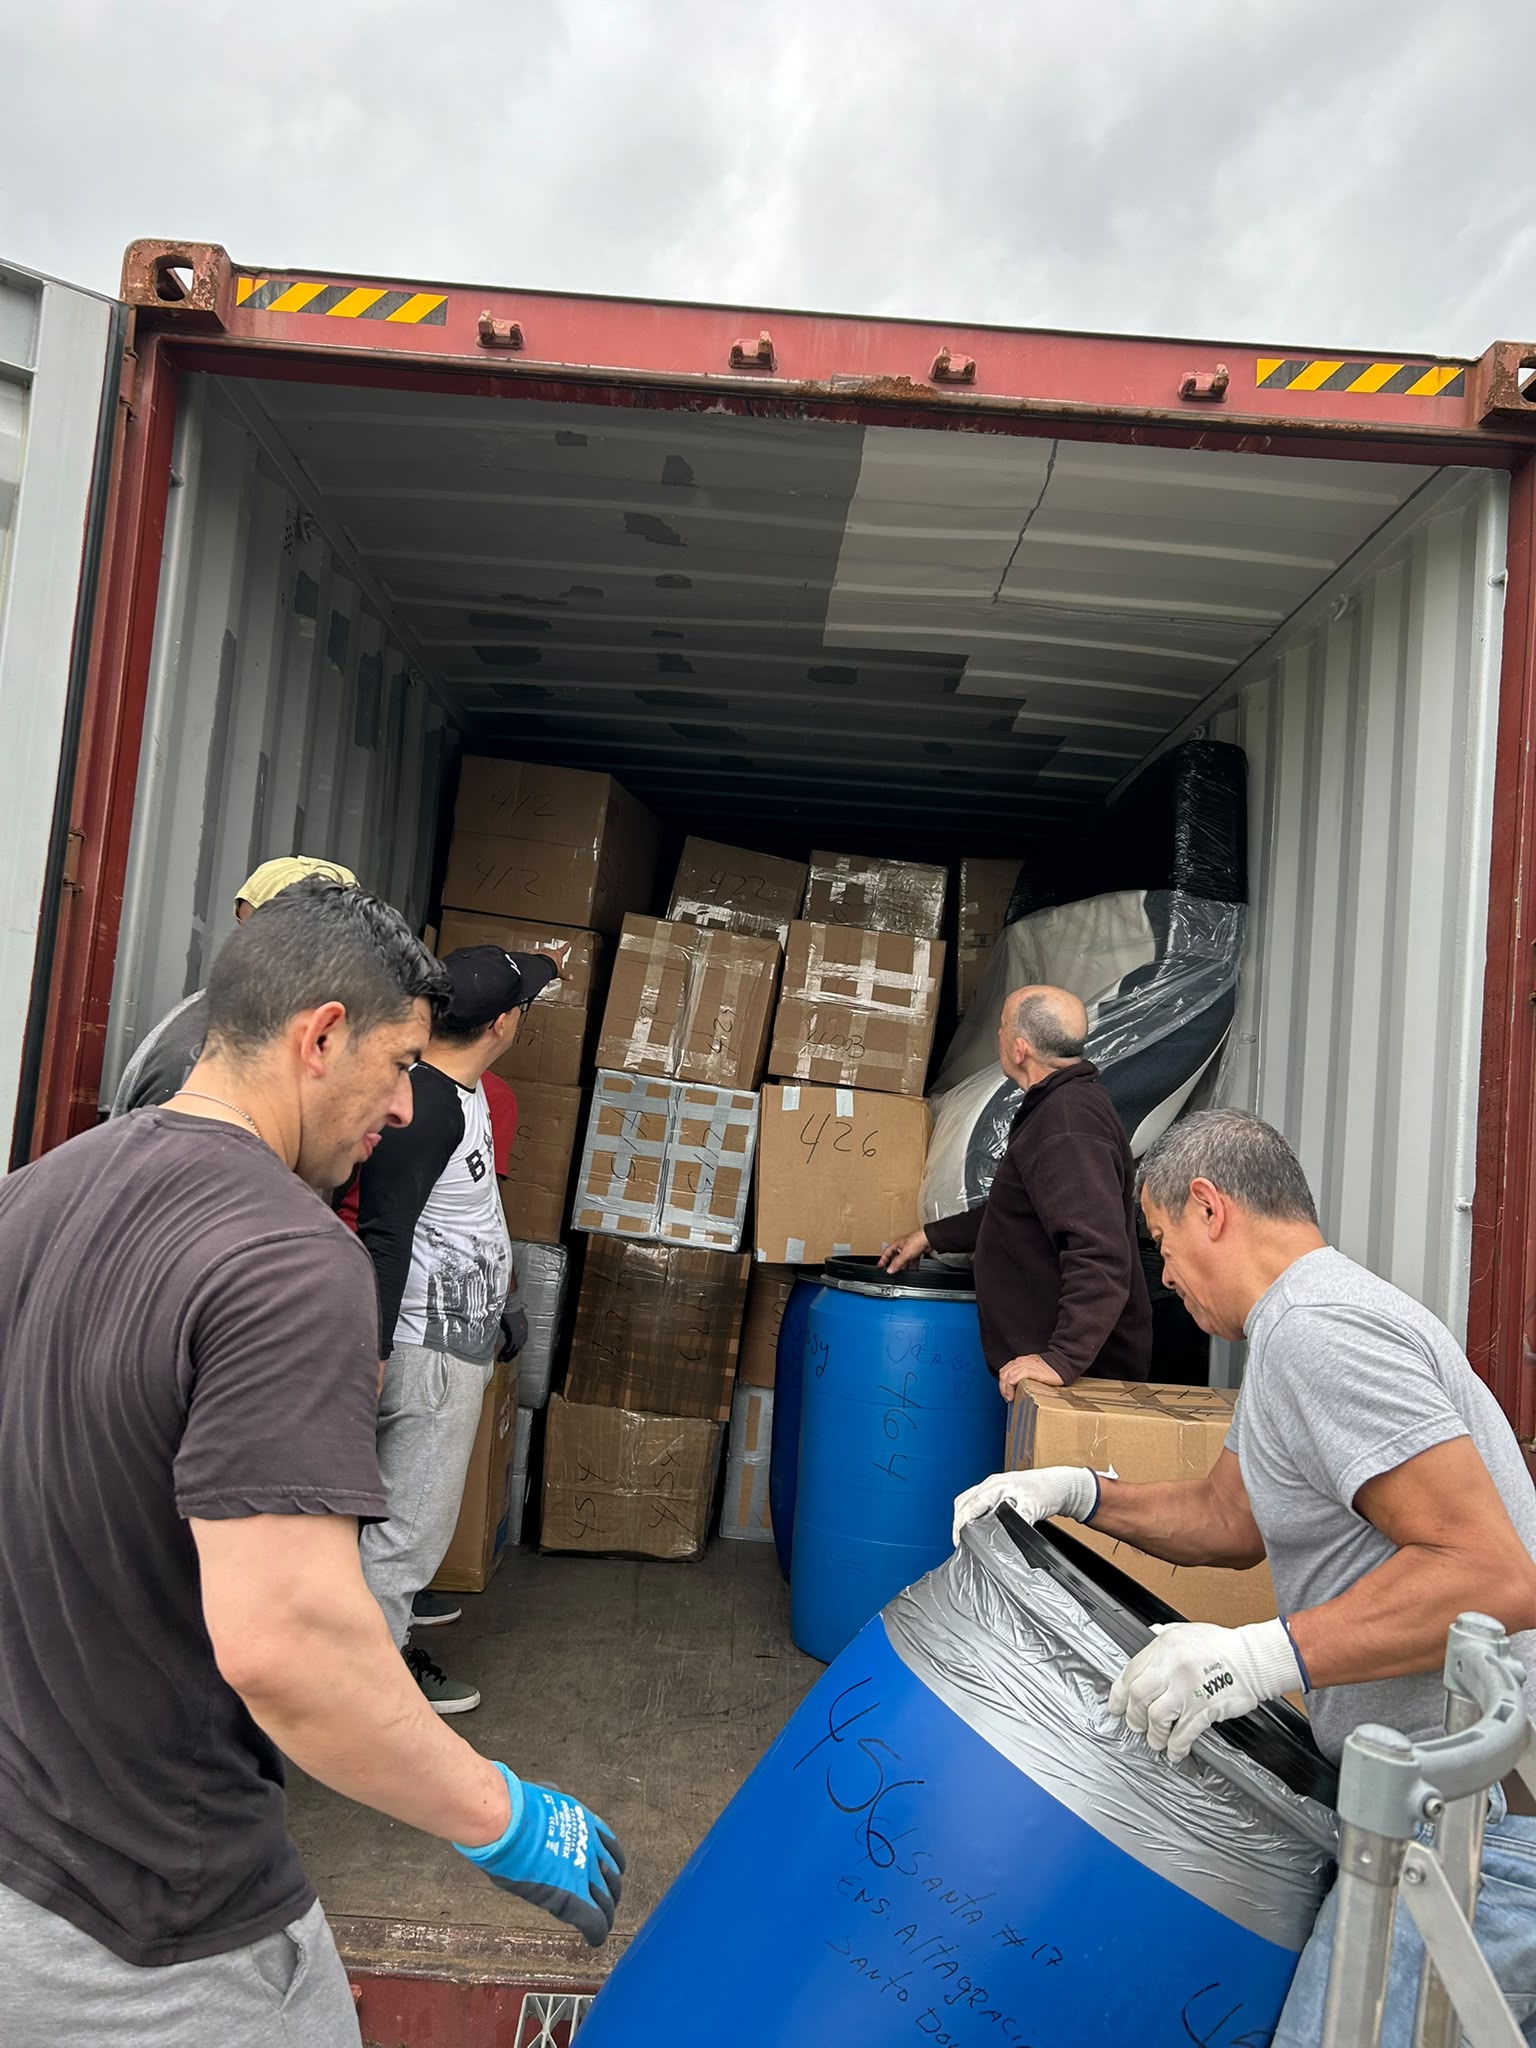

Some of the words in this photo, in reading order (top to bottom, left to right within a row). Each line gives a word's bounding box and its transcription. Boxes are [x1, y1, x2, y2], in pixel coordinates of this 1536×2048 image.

[490, 793, 557, 817] 412
[474, 858, 544, 897] 412
[710, 870, 771, 902] 422
[799, 1113, 879, 1164] 426
[871, 1371, 923, 1481] 464
[793, 1677, 925, 1868] 456
